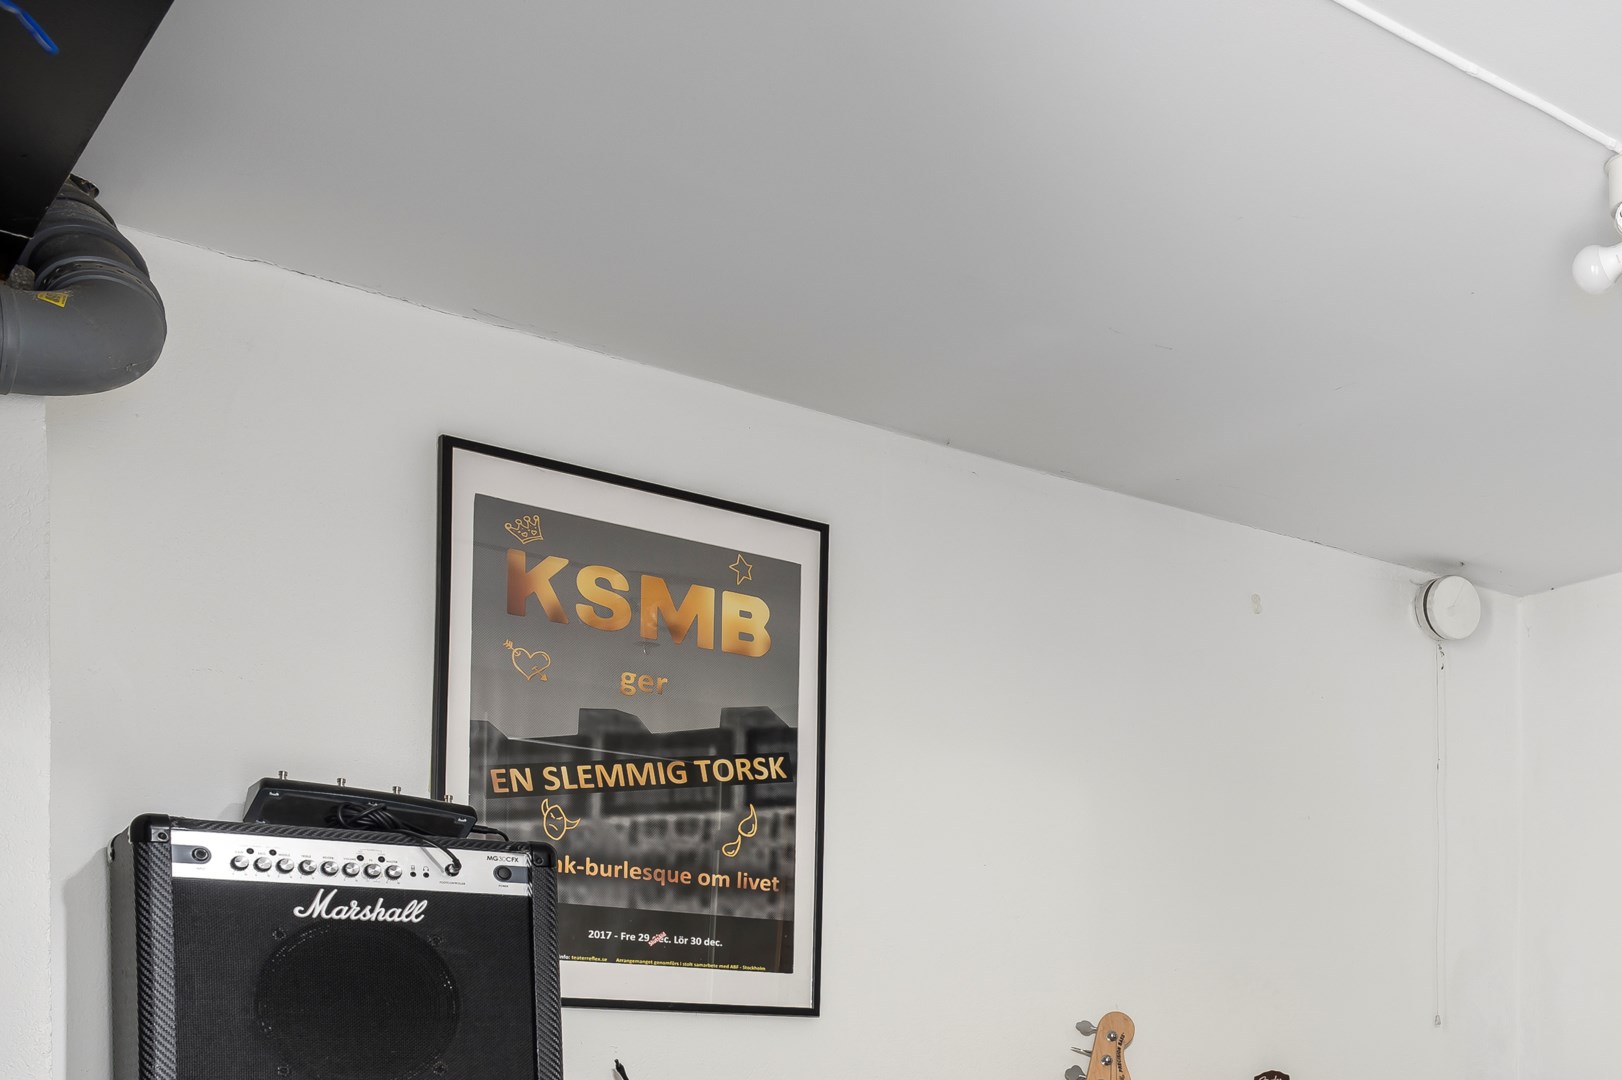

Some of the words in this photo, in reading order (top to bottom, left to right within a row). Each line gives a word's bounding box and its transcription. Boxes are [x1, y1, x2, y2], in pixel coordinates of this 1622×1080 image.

[507, 548, 772, 657] KSMB
[620, 671, 667, 696] ger
[490, 768, 534, 793] EN
[542, 760, 688, 791] SLEMMIG
[694, 757, 787, 782] TORSK
[558, 855, 692, 886] nk-burlesque
[698, 872, 730, 888] om
[737, 872, 780, 892] livet
[293, 889, 428, 922] Marshall
[588, 930, 612, 940] 2017
[620, 932, 636, 942] Fre
[638, 934, 649, 942] 29
[674, 934, 688, 944] Lör
[690, 936, 702, 945] 30
[704, 936, 722, 946] dec.
